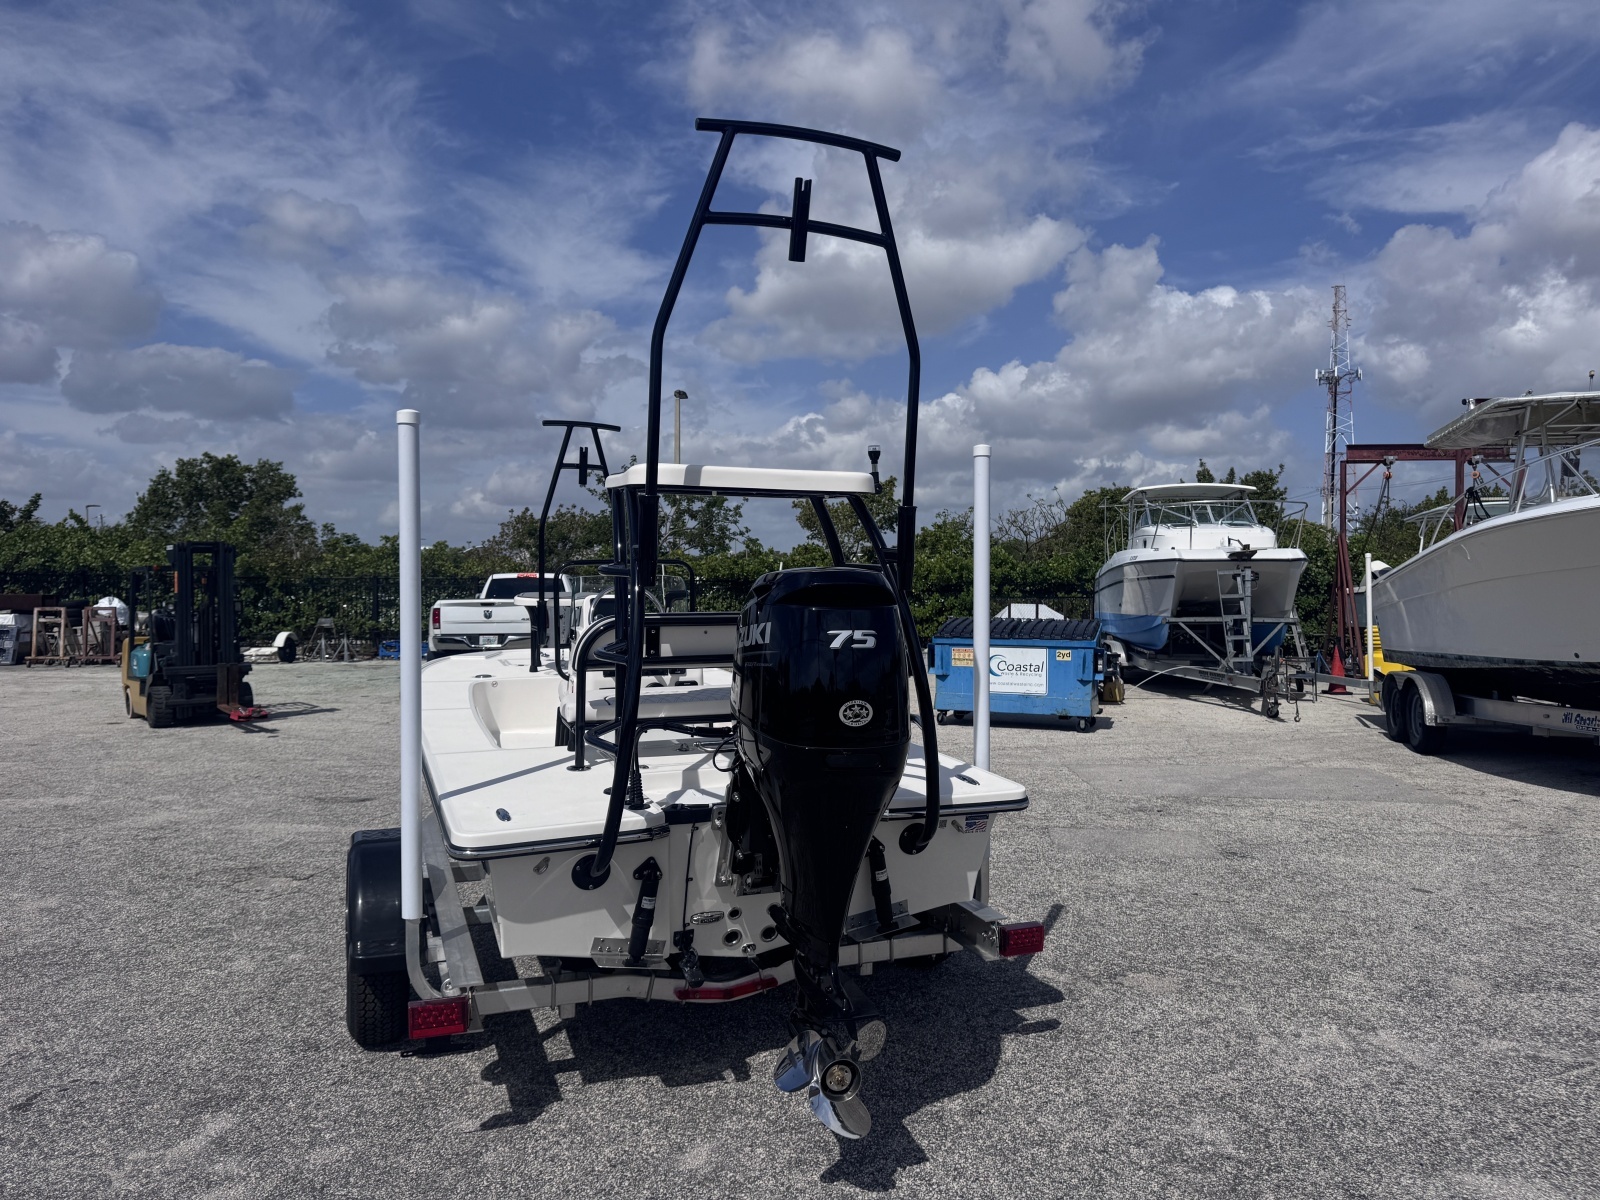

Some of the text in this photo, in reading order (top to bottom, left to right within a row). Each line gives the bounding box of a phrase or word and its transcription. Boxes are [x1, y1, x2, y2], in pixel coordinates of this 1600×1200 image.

[738, 622, 772, 648] ZUKI
[827, 630, 878, 649] 75
[1056, 651, 1071, 659] 2yd
[997, 660, 1045, 673] Coastal
